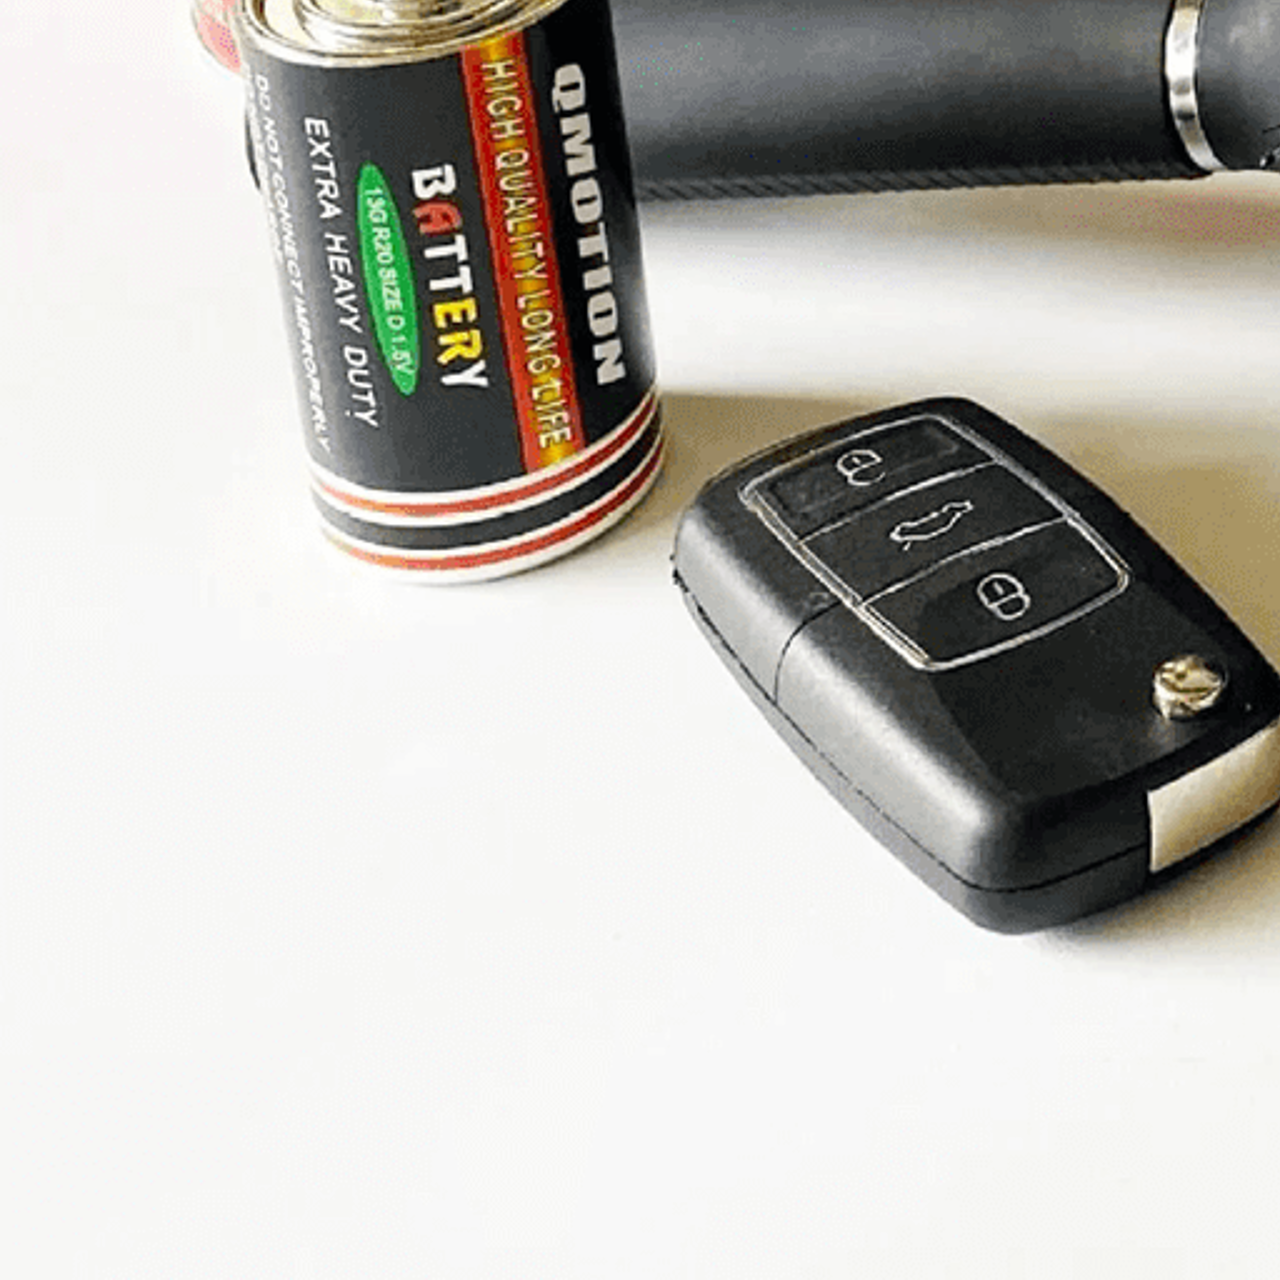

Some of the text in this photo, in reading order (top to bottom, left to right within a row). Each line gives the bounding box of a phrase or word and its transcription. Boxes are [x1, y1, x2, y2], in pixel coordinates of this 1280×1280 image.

[304, 116, 380, 428] EXTRA HEAVY DUTY
[371, 226, 394, 266] R20
[377, 265, 403, 314] SIZE
[411, 163, 490, 389] BATTERY
[480, 60, 573, 451] HIGH QUALITY LONG LIFE
[551, 62, 626, 387] QMOTION
